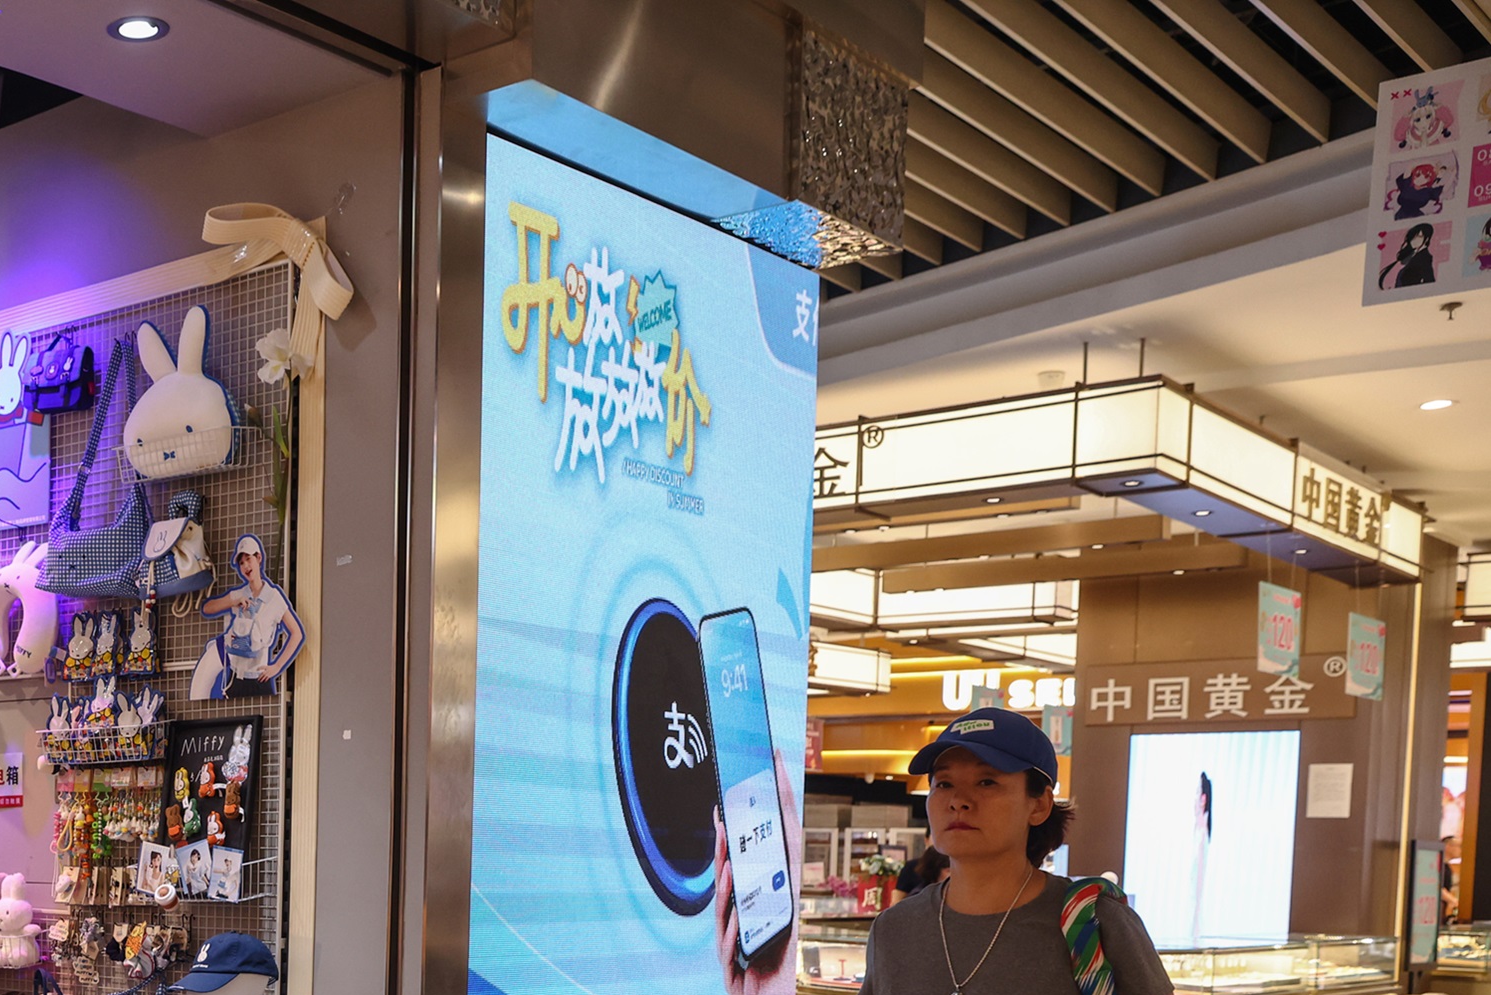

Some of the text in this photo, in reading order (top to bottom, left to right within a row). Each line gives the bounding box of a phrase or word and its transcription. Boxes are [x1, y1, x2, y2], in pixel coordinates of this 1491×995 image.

[637, 300, 672, 332] WELCOME
[1302, 467, 1380, 546] 中国黄金
[721, 664, 749, 698] 9:41
[1090, 673, 1314, 722] 中国黄金
